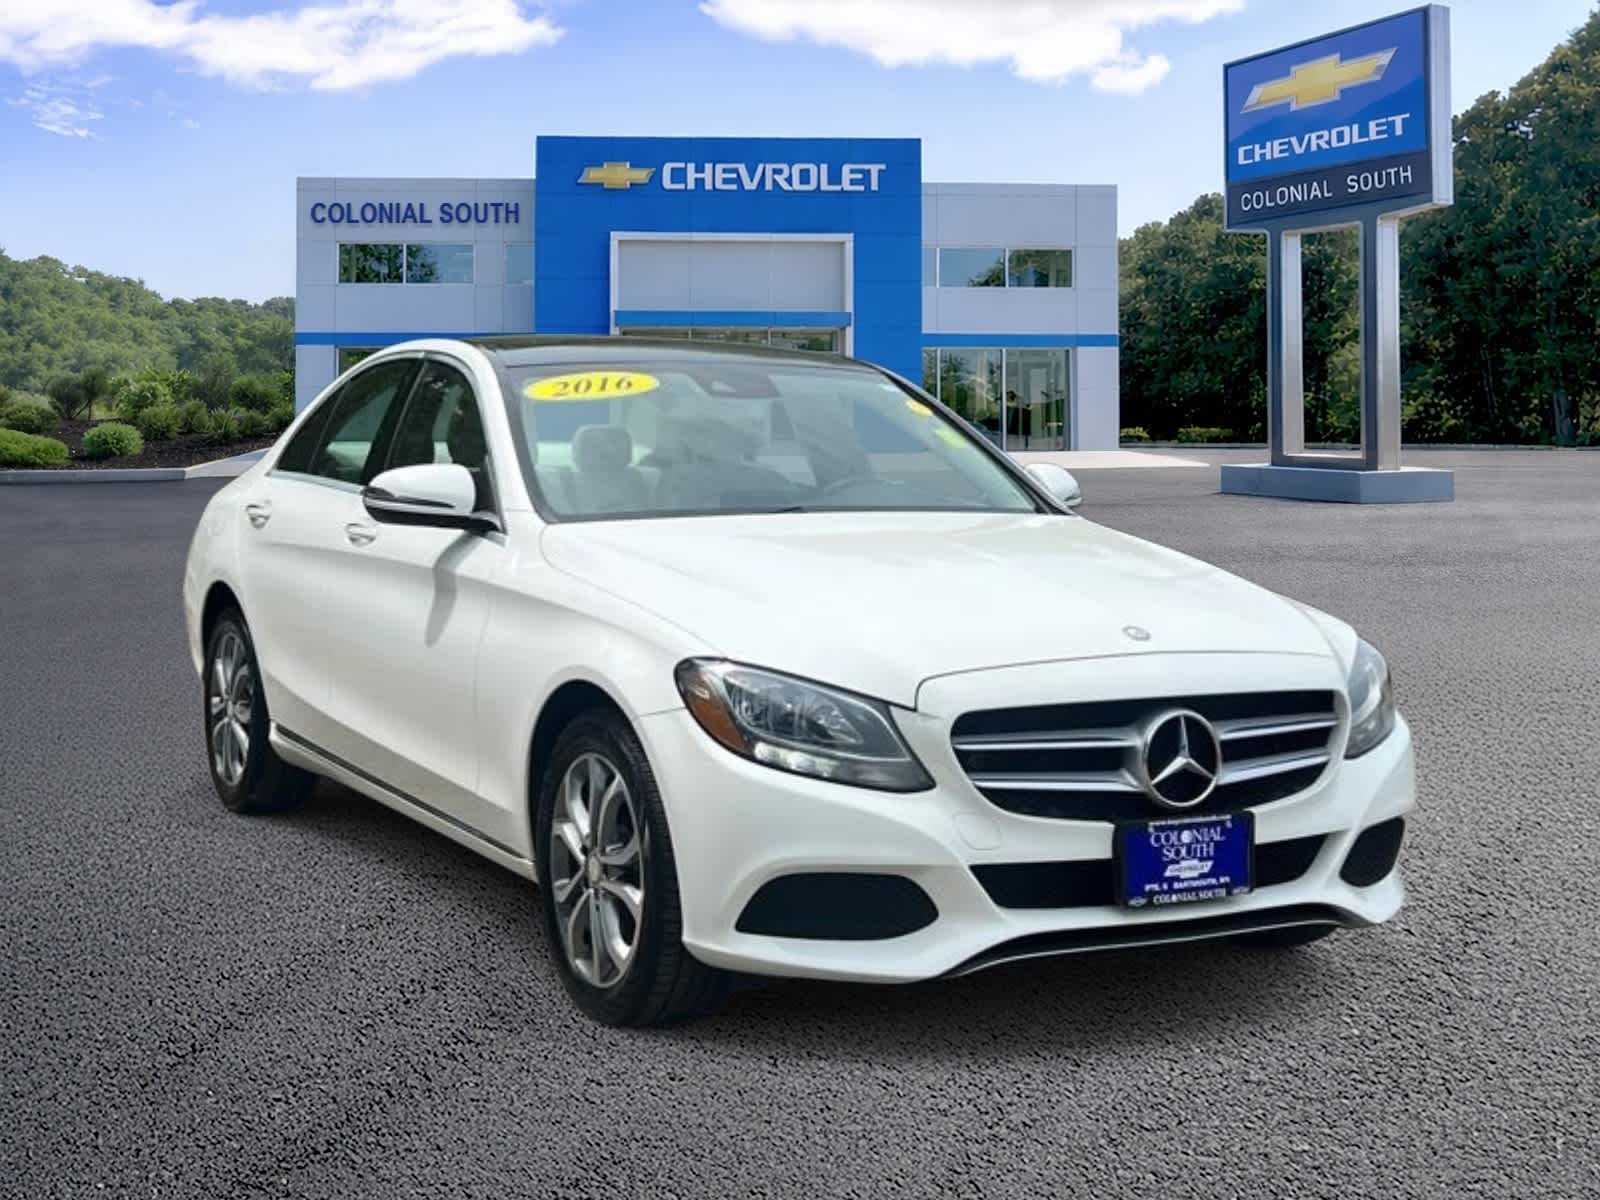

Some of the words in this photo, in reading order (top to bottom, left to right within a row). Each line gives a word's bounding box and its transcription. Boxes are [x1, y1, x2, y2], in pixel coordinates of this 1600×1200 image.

[1237, 113, 1410, 165] CHEVROLET
[662, 162, 887, 192] CHEVROLET
[1240, 180, 1333, 212] COLONIAL
[1346, 165, 1413, 194] SOUTH
[310, 202, 433, 224] COLONIAL
[439, 202, 520, 224] SOUTH
[551, 376, 633, 397] 2016
[1150, 826, 1226, 848] COLONIAL
[1162, 842, 1215, 861] SOUTH
